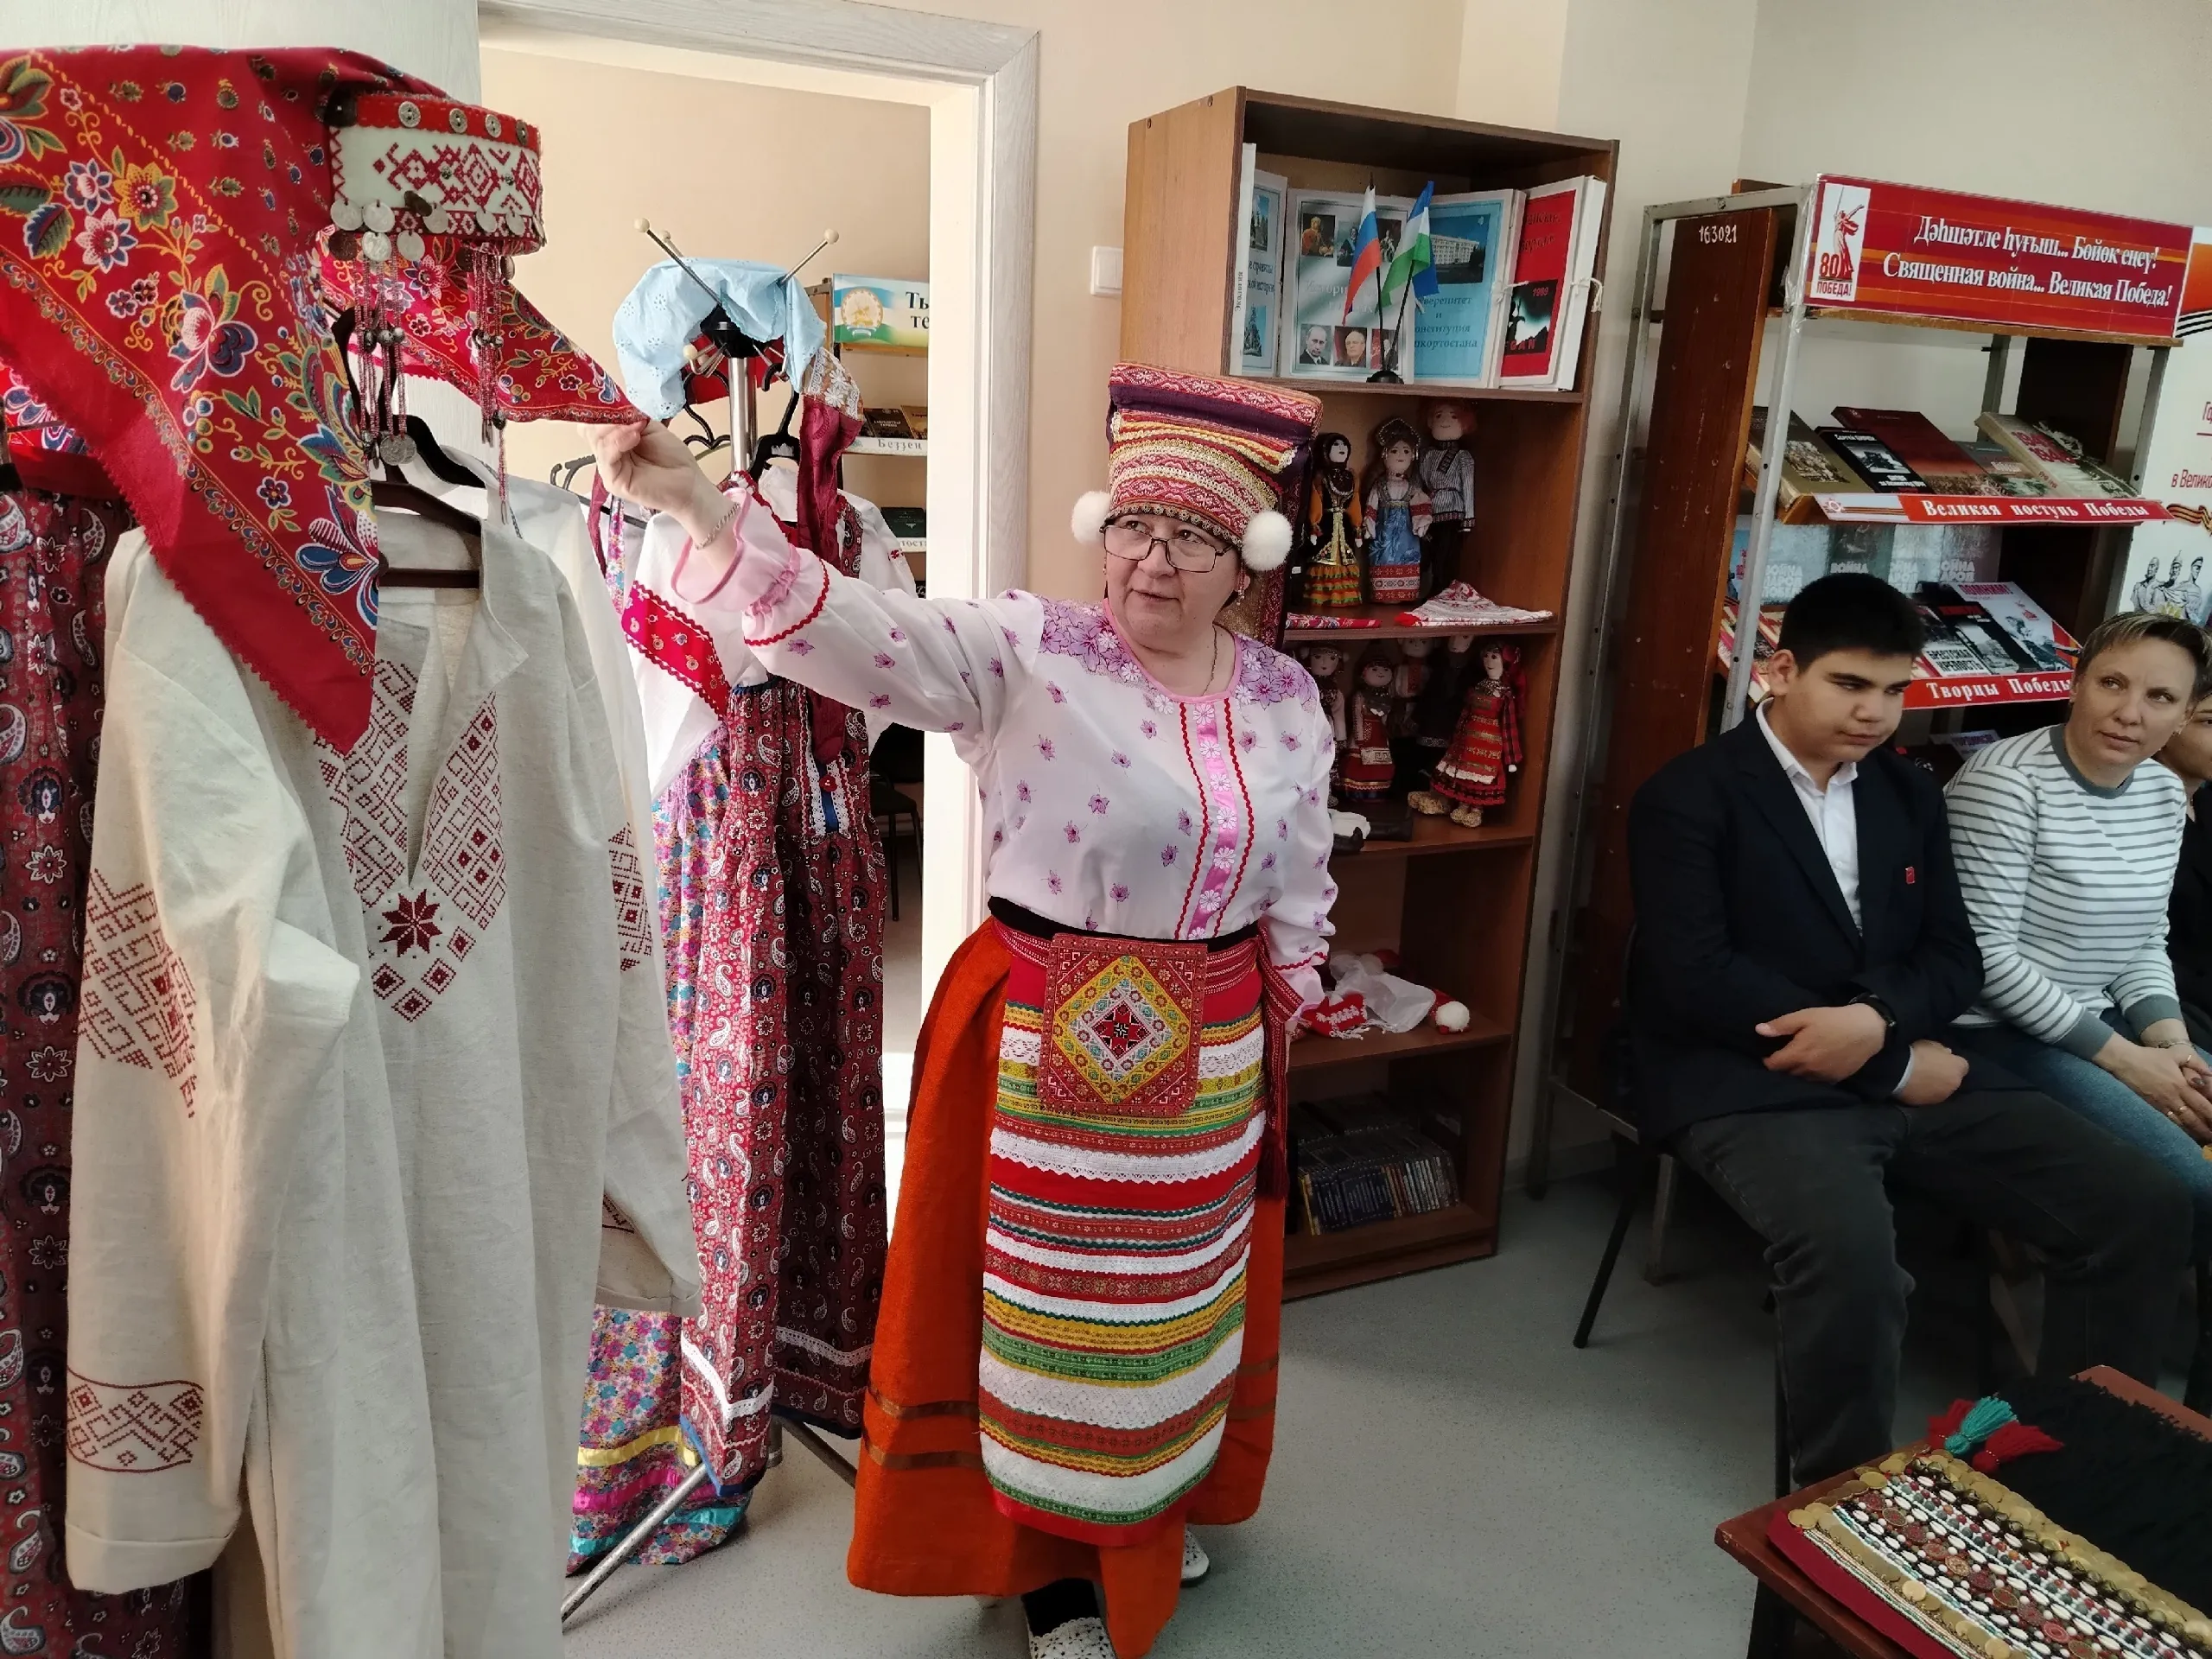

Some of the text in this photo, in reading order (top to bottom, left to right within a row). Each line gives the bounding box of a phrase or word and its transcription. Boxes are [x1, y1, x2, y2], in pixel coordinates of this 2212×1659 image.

[1699, 225, 1738, 245] 163021
[1913, 216, 2000, 246] Дәһшәтле
[2071, 236, 2119, 264] Бөйөк
[1820, 252, 1840, 278] 80
[1883, 251, 2173, 308] Священная война... Великая Победа!
[1306, 279, 1348, 297] Истори
[1816, 281, 1853, 297] ПОБЕДА!
[1419, 296, 1473, 308] веренитет
[1414, 325, 1471, 335] онституция
[1414, 339, 1478, 351] шкортостана
[1506, 338, 1536, 351] GAN
[2170, 474, 2179, 488] в
[1922, 499, 2150, 518] Великая поступь Победы
[1941, 558, 1975, 572] ОЙНА
[1940, 570, 1975, 582] АРОД
[1926, 648, 1974, 661] БРЕСТСКАЯ
[1936, 660, 1984, 672] КРЕПОСТЬ
[1925, 677, 2071, 702] Творцы Победы
